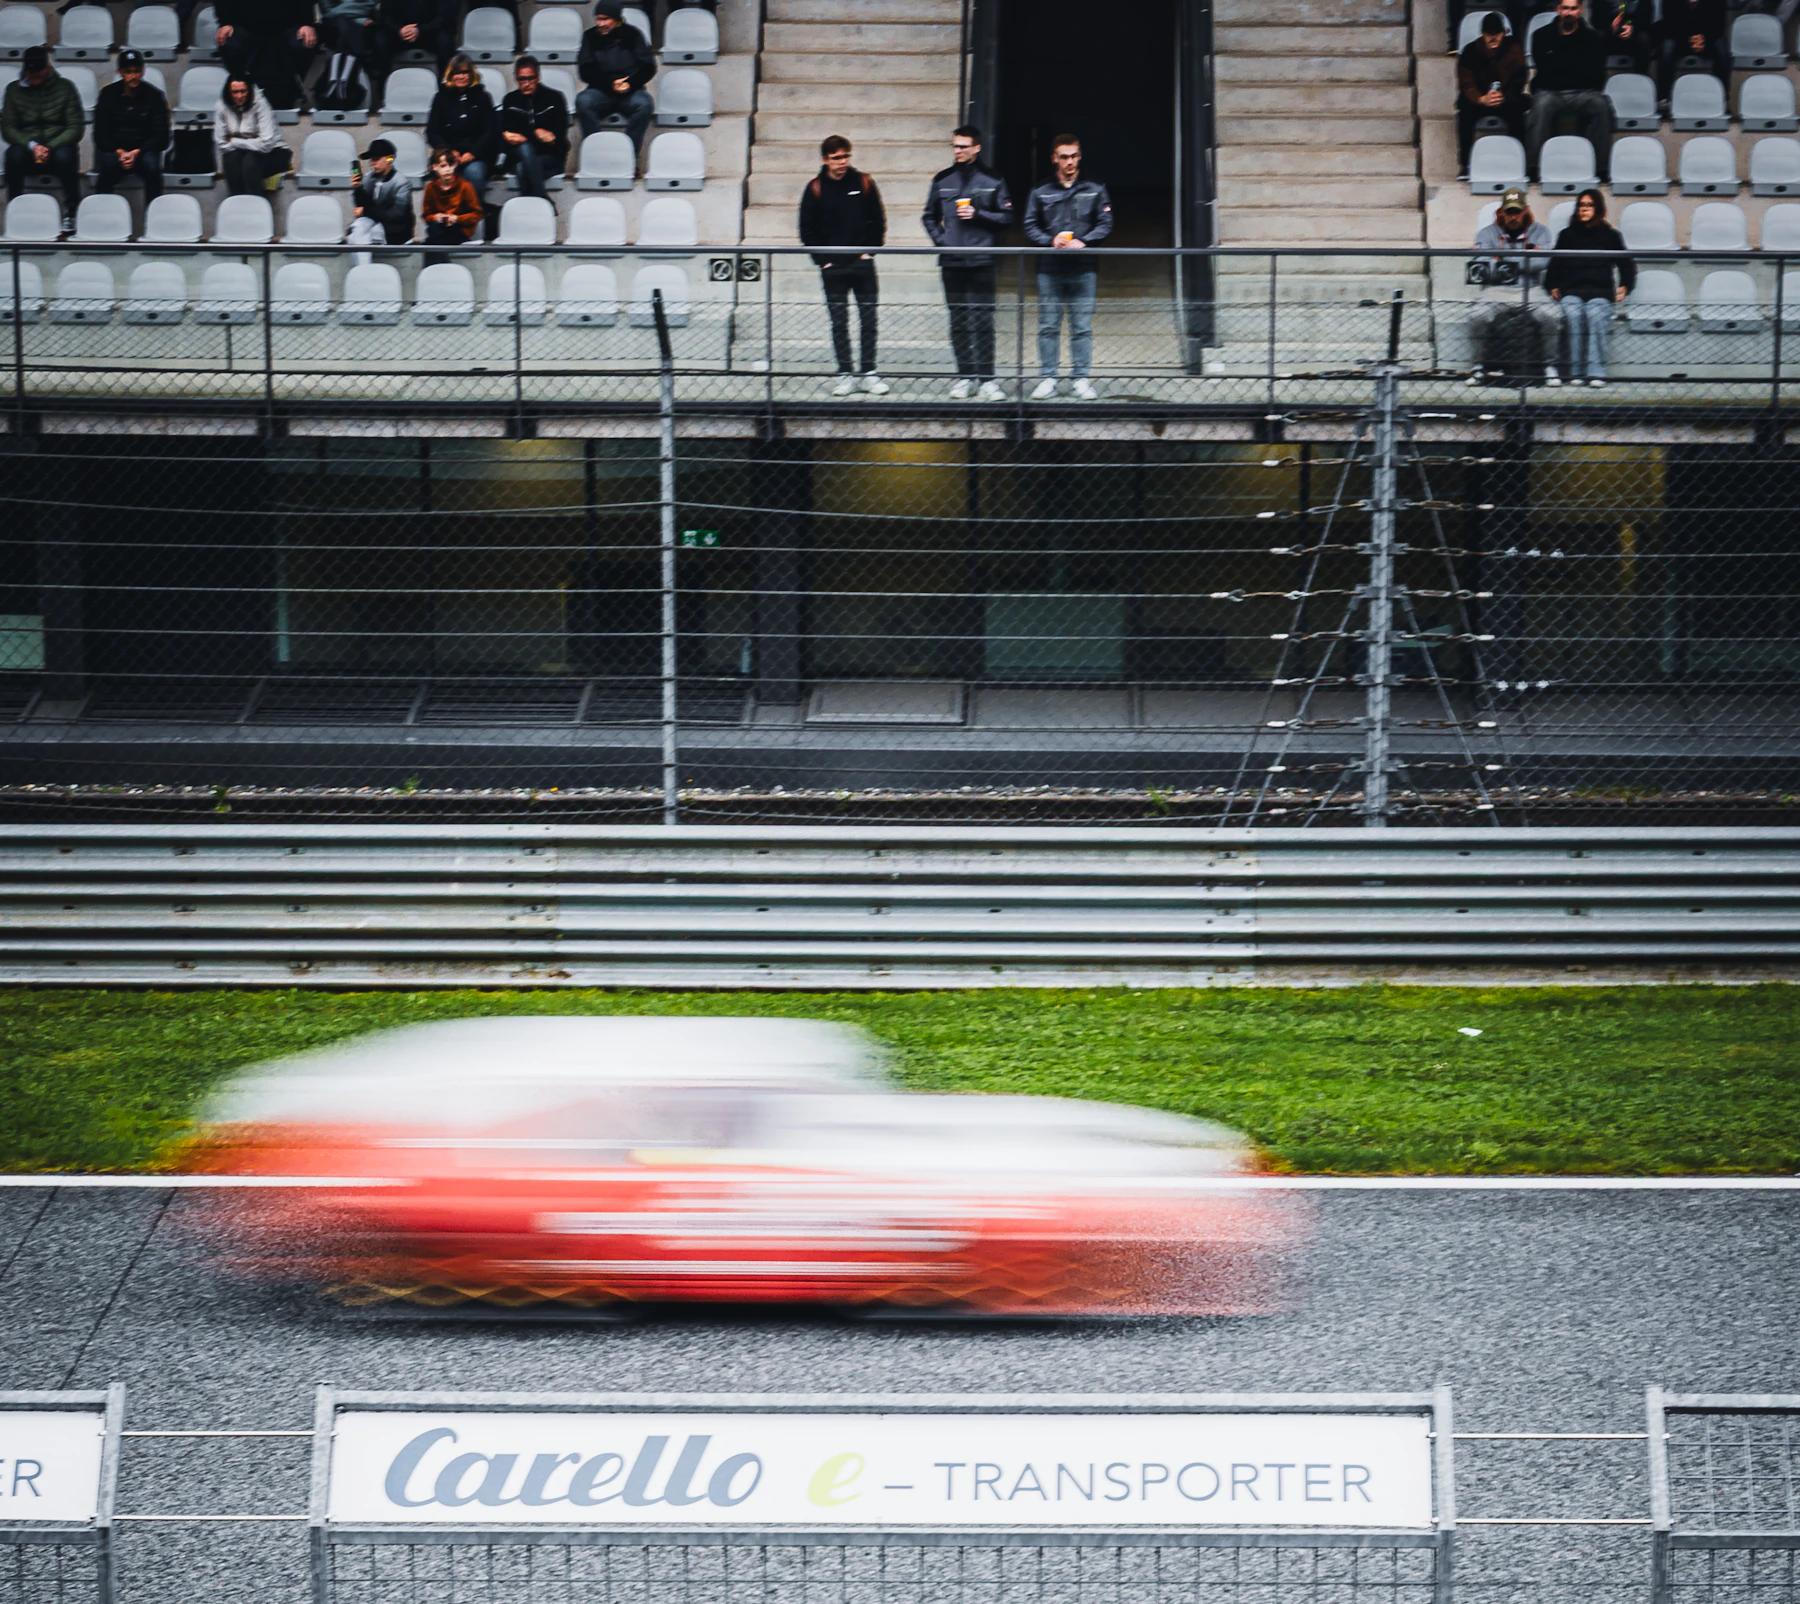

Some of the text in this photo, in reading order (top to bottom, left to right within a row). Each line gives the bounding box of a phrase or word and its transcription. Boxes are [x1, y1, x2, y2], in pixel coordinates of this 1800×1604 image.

[0, 1458, 42, 1497] R
[384, 1427, 763, 1508] Carello
[808, 1452, 864, 1507] e
[934, 1462, 1372, 1503] TRANSPORTER
